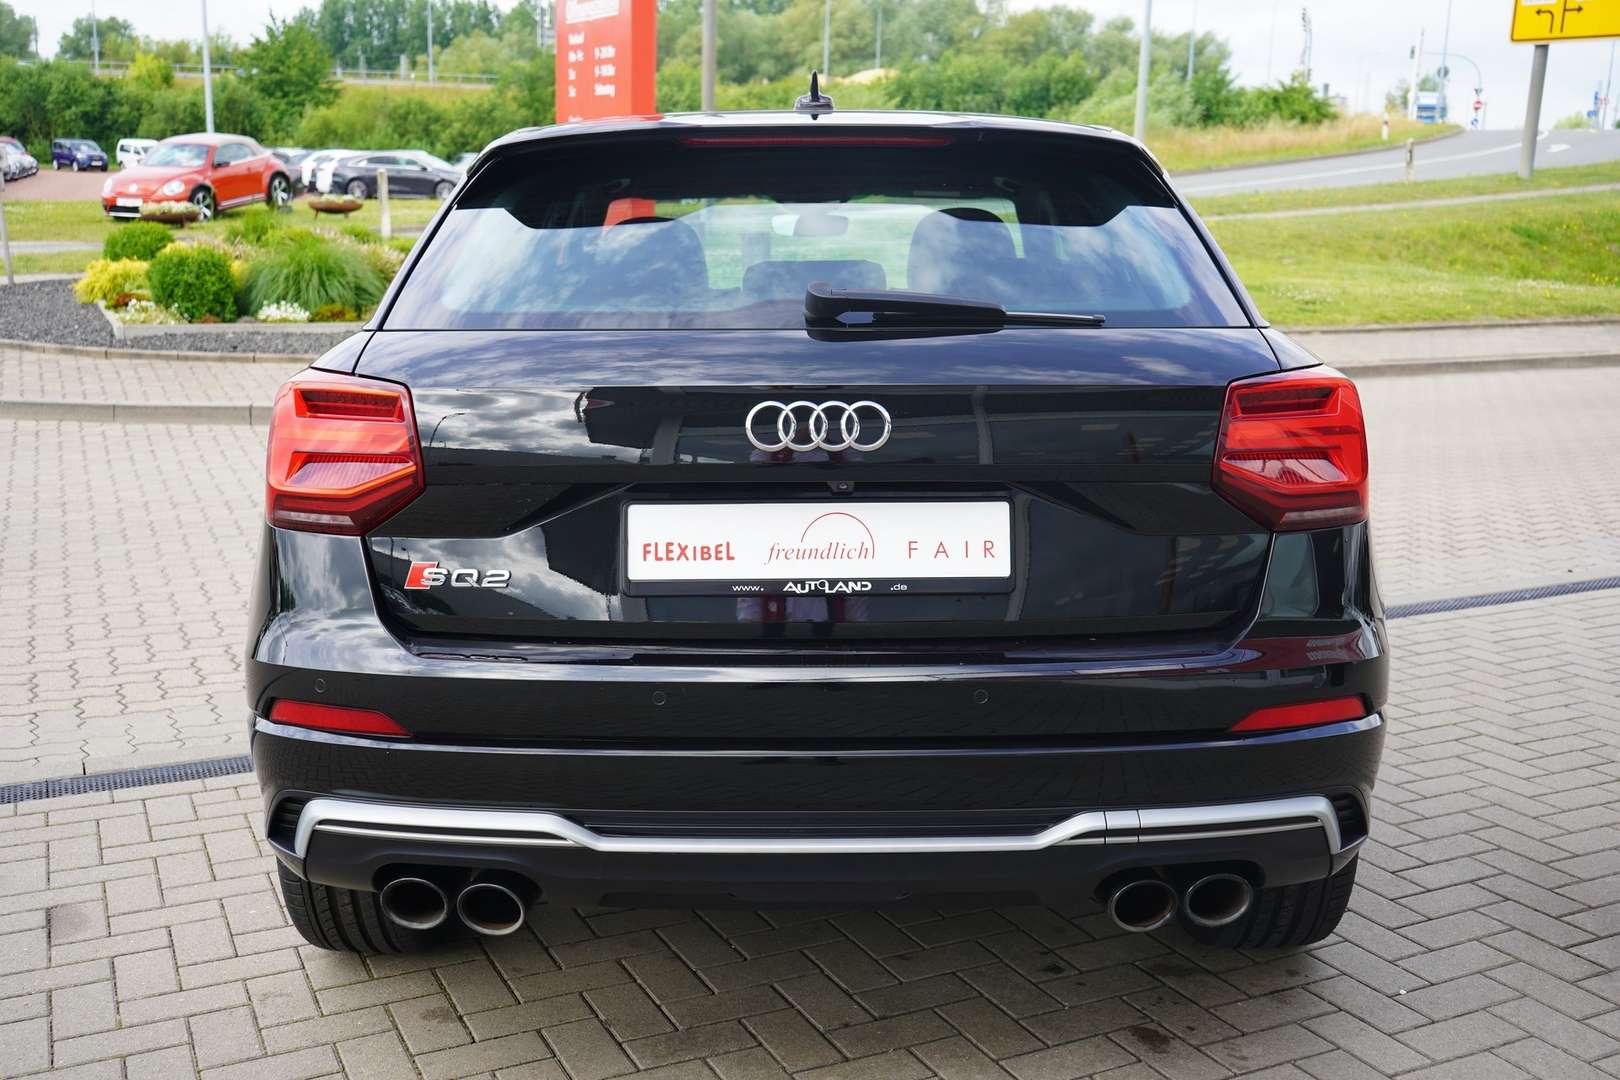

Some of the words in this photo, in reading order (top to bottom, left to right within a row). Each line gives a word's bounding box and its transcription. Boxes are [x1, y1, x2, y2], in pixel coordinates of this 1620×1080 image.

[763, 541, 870, 566] freundlich
[908, 540, 995, 559] FAIR
[419, 567, 510, 588] SQ2
[731, 584, 764, 592] www.
[782, 579, 873, 594] AUTOLAND
